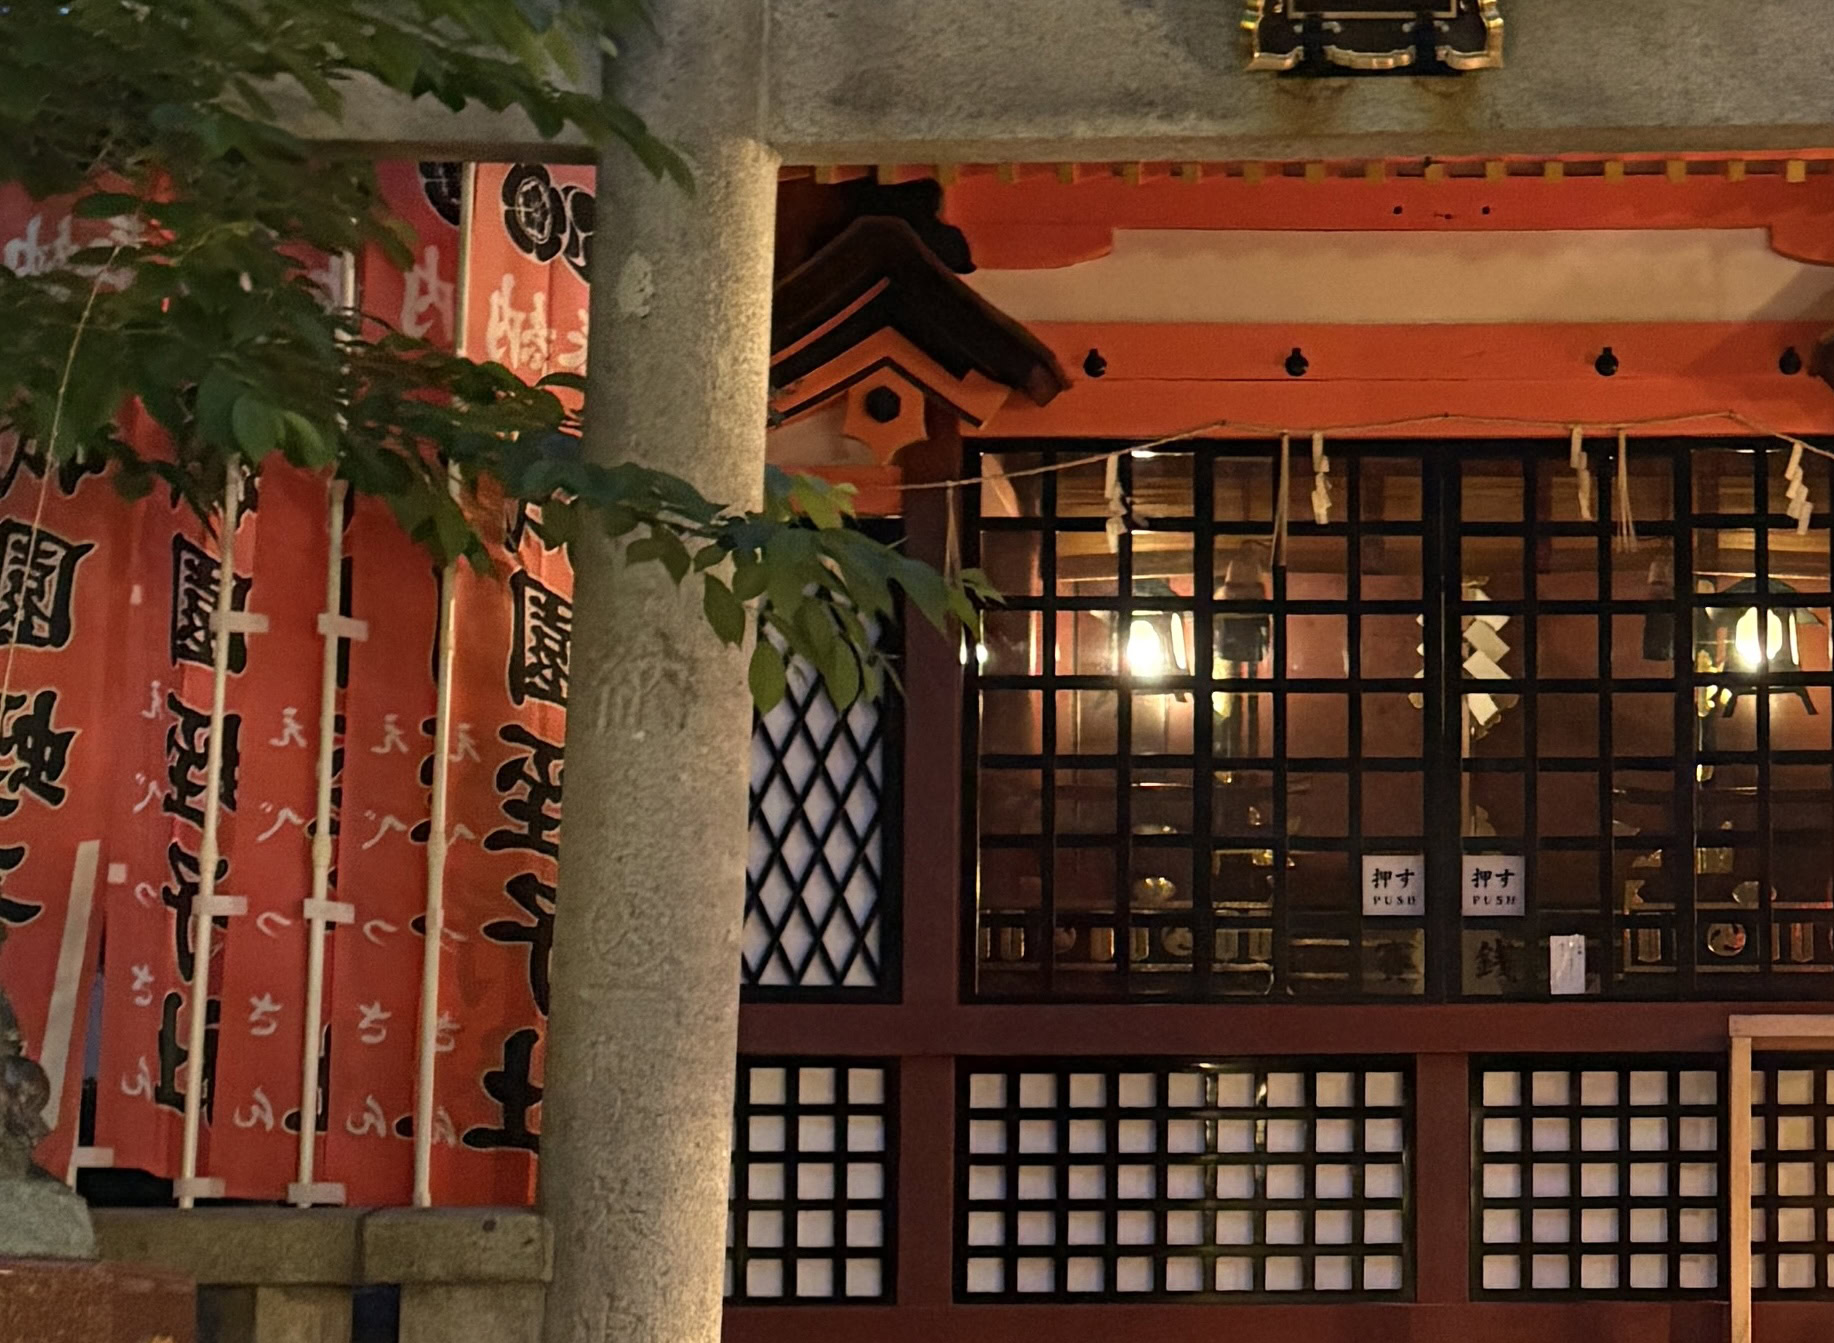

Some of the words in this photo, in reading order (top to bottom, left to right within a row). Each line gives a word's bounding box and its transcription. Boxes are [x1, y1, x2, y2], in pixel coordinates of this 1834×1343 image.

[1372, 867, 1416, 889] 押す
[1471, 867, 1515, 889] 押す
[1373, 895, 1417, 906] PUSH
[1472, 895, 1517, 906] PUSH
